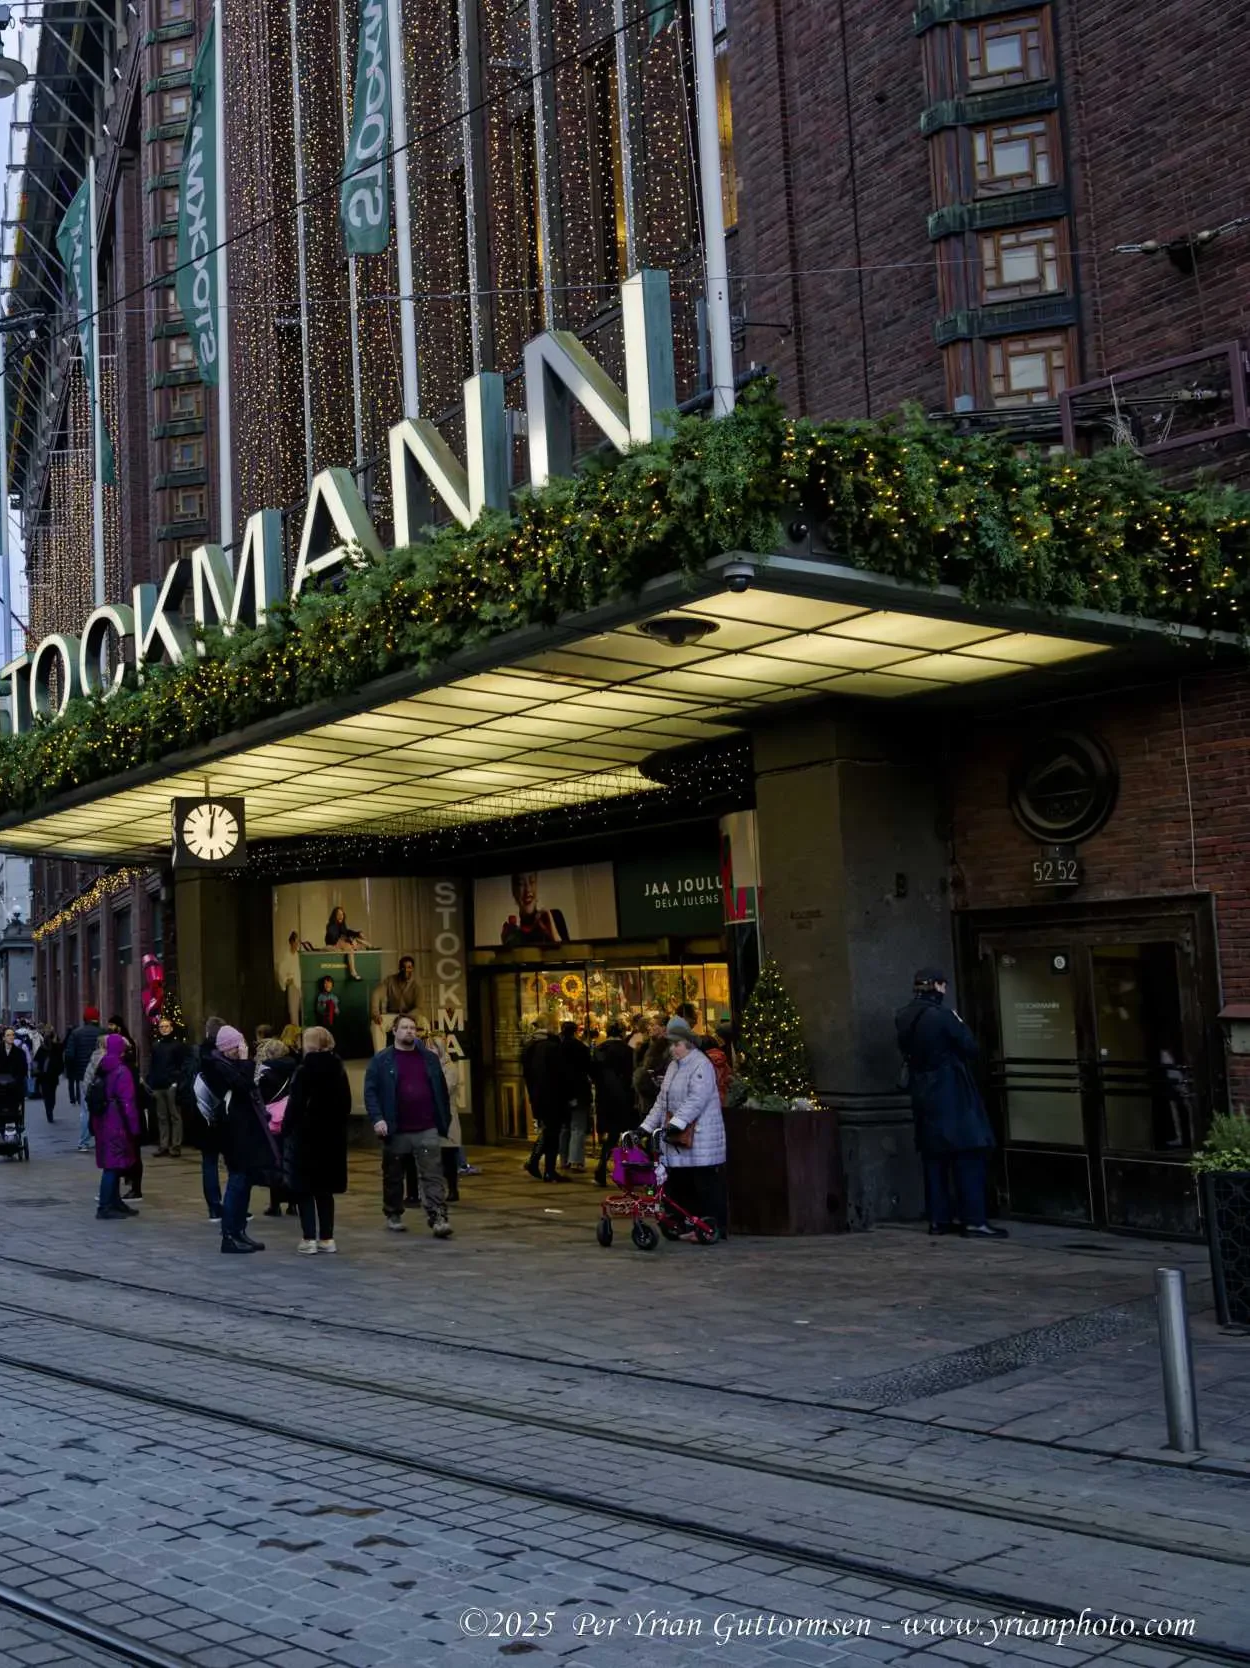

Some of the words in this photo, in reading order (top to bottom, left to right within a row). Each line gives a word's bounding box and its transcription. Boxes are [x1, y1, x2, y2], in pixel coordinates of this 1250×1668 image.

[644, 880, 671, 897] JAA
[655, 897, 679, 909] DELA
[682, 894, 720, 907] JULENS
[433, 881, 467, 1108] STOCKMA
